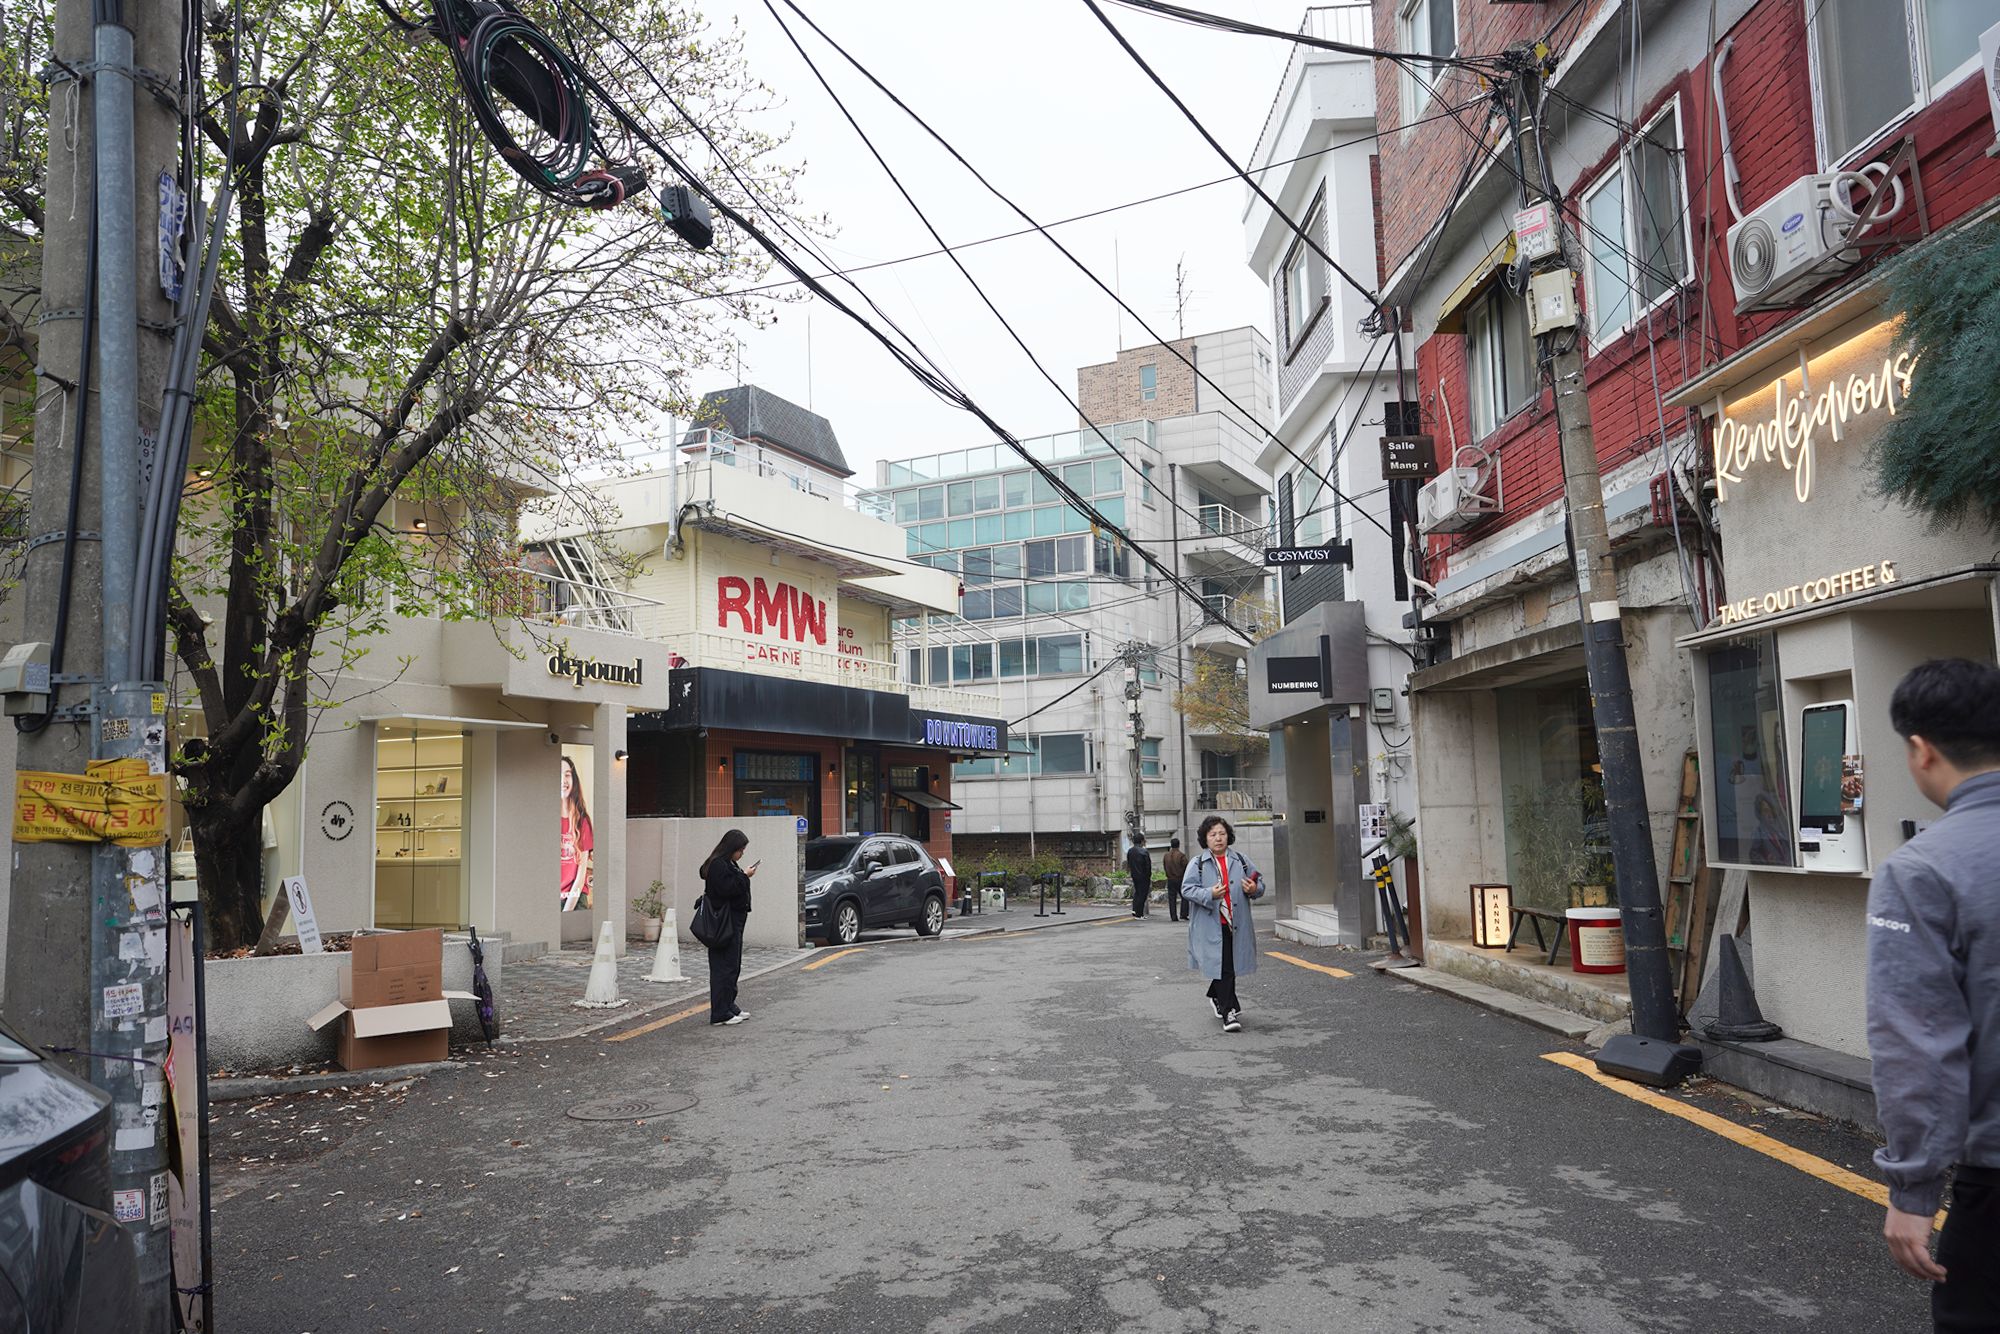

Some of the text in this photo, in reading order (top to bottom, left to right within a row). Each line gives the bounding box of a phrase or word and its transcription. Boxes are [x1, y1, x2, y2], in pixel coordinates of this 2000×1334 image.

[1388, 442, 1415, 450] Salle
[718, 576, 827, 645] RMW
[1719, 560, 1896, 625] TAKE-OUT COFFEE &
[547, 648, 643, 687] depound
[1271, 681, 1319, 689] NUMBERING
[926, 719, 998, 749] DOWNTOWNER
[1492, 893, 1501, 933] HANNA
